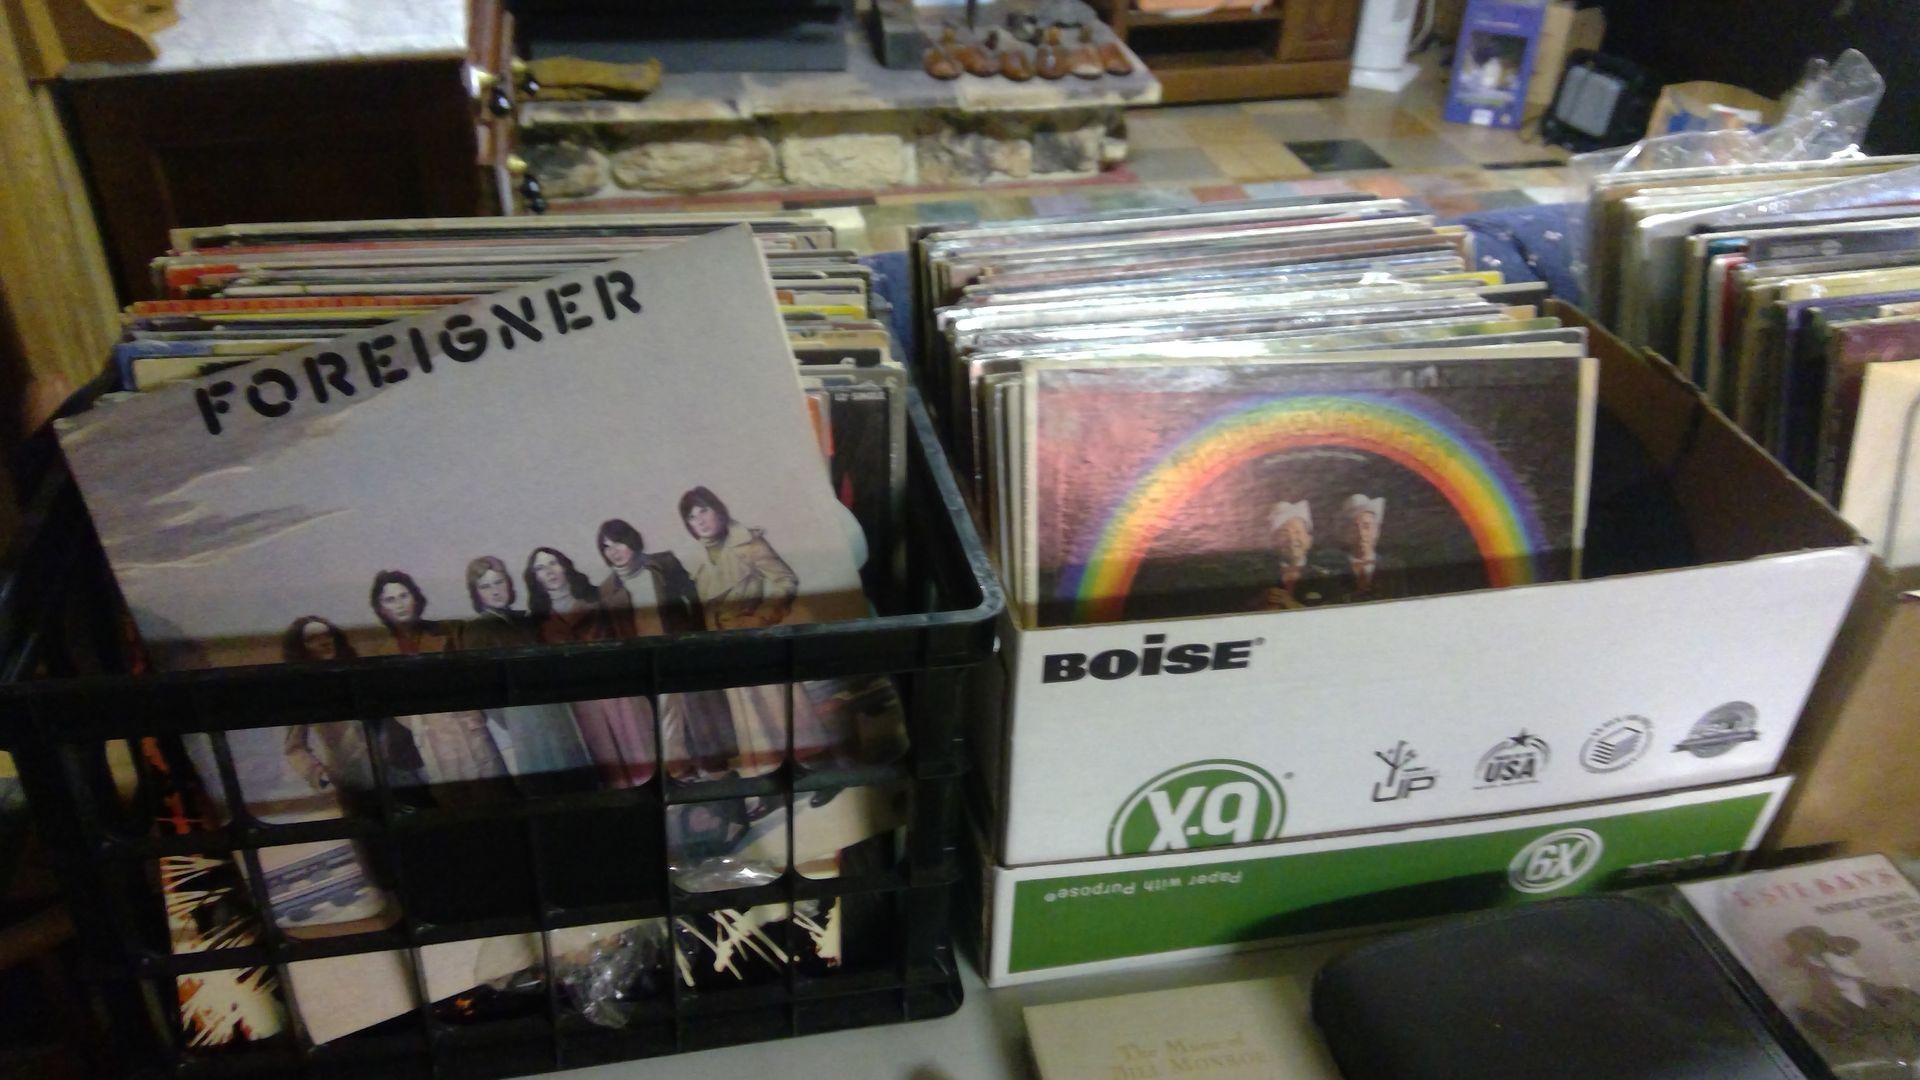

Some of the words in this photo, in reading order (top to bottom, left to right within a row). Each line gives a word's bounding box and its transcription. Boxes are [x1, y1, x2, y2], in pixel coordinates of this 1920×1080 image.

[195, 270, 642, 435] FOREIGNER
[1484, 757, 1536, 783] USA
[1143, 876, 1182, 892] with
[1188, 871, 1243, 887] Paper
